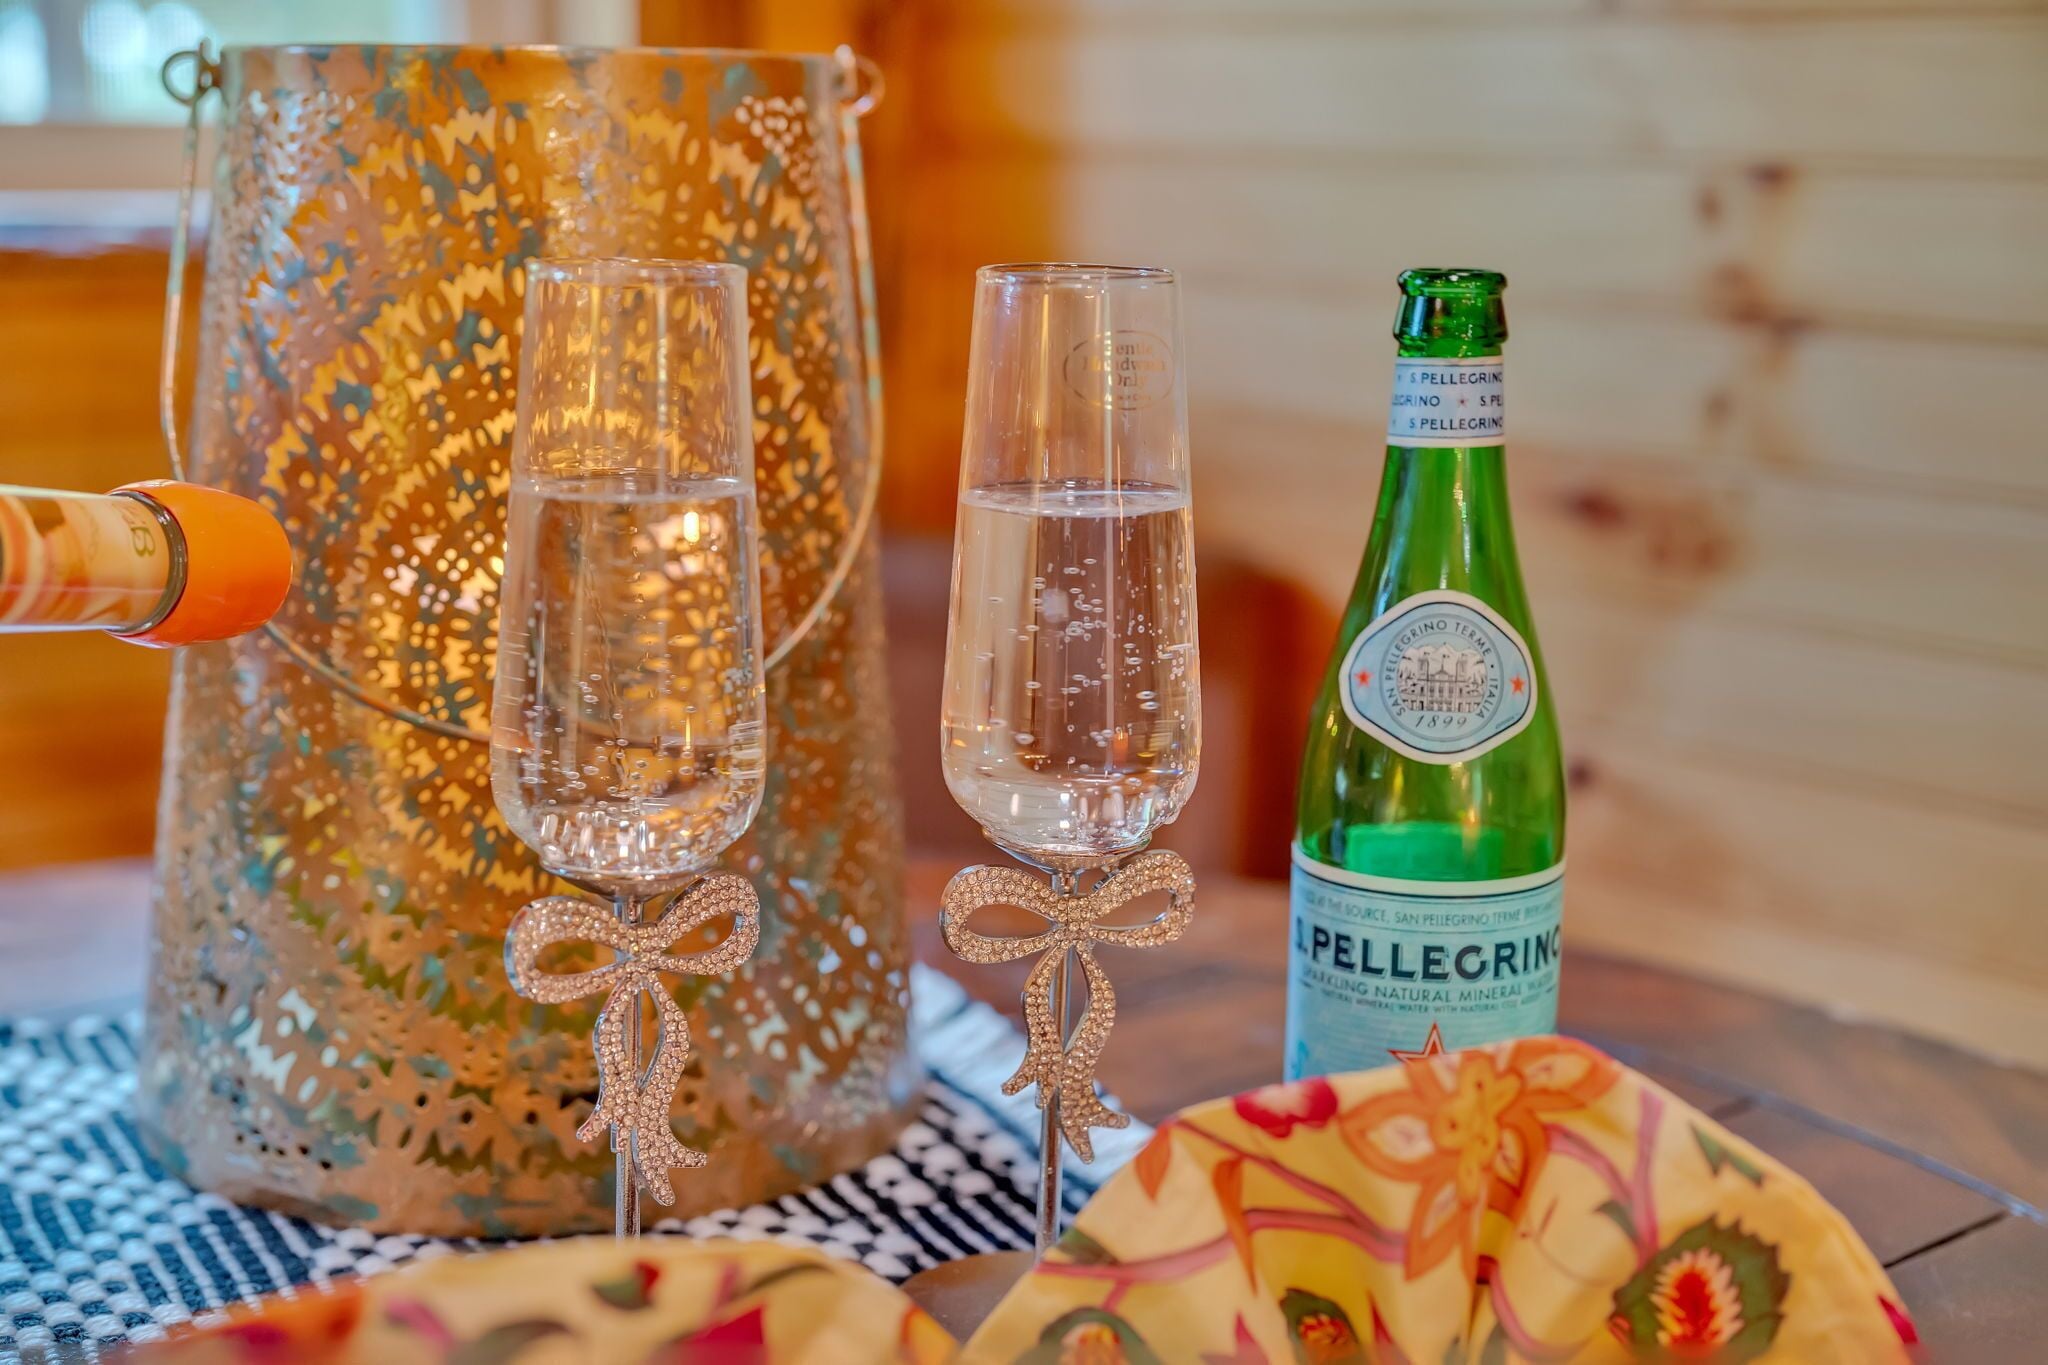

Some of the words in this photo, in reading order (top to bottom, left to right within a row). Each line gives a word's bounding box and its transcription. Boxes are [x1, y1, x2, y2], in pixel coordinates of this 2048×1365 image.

[1385, 619, 1448, 681] PELLEGRINO
[1454, 622, 1492, 656] TERME
[1386, 687, 1406, 717] SAN
[1475, 678, 1499, 719] ITALIA
[1416, 714, 1468, 729] 1899
[1395, 911, 1420, 924] SAN
[1423, 913, 1490, 927] PELLEGRINO
[1493, 908, 1521, 923] TERME
[1375, 985, 1451, 1003] NATURAL
[1459, 984, 1522, 1002] MINERAL
